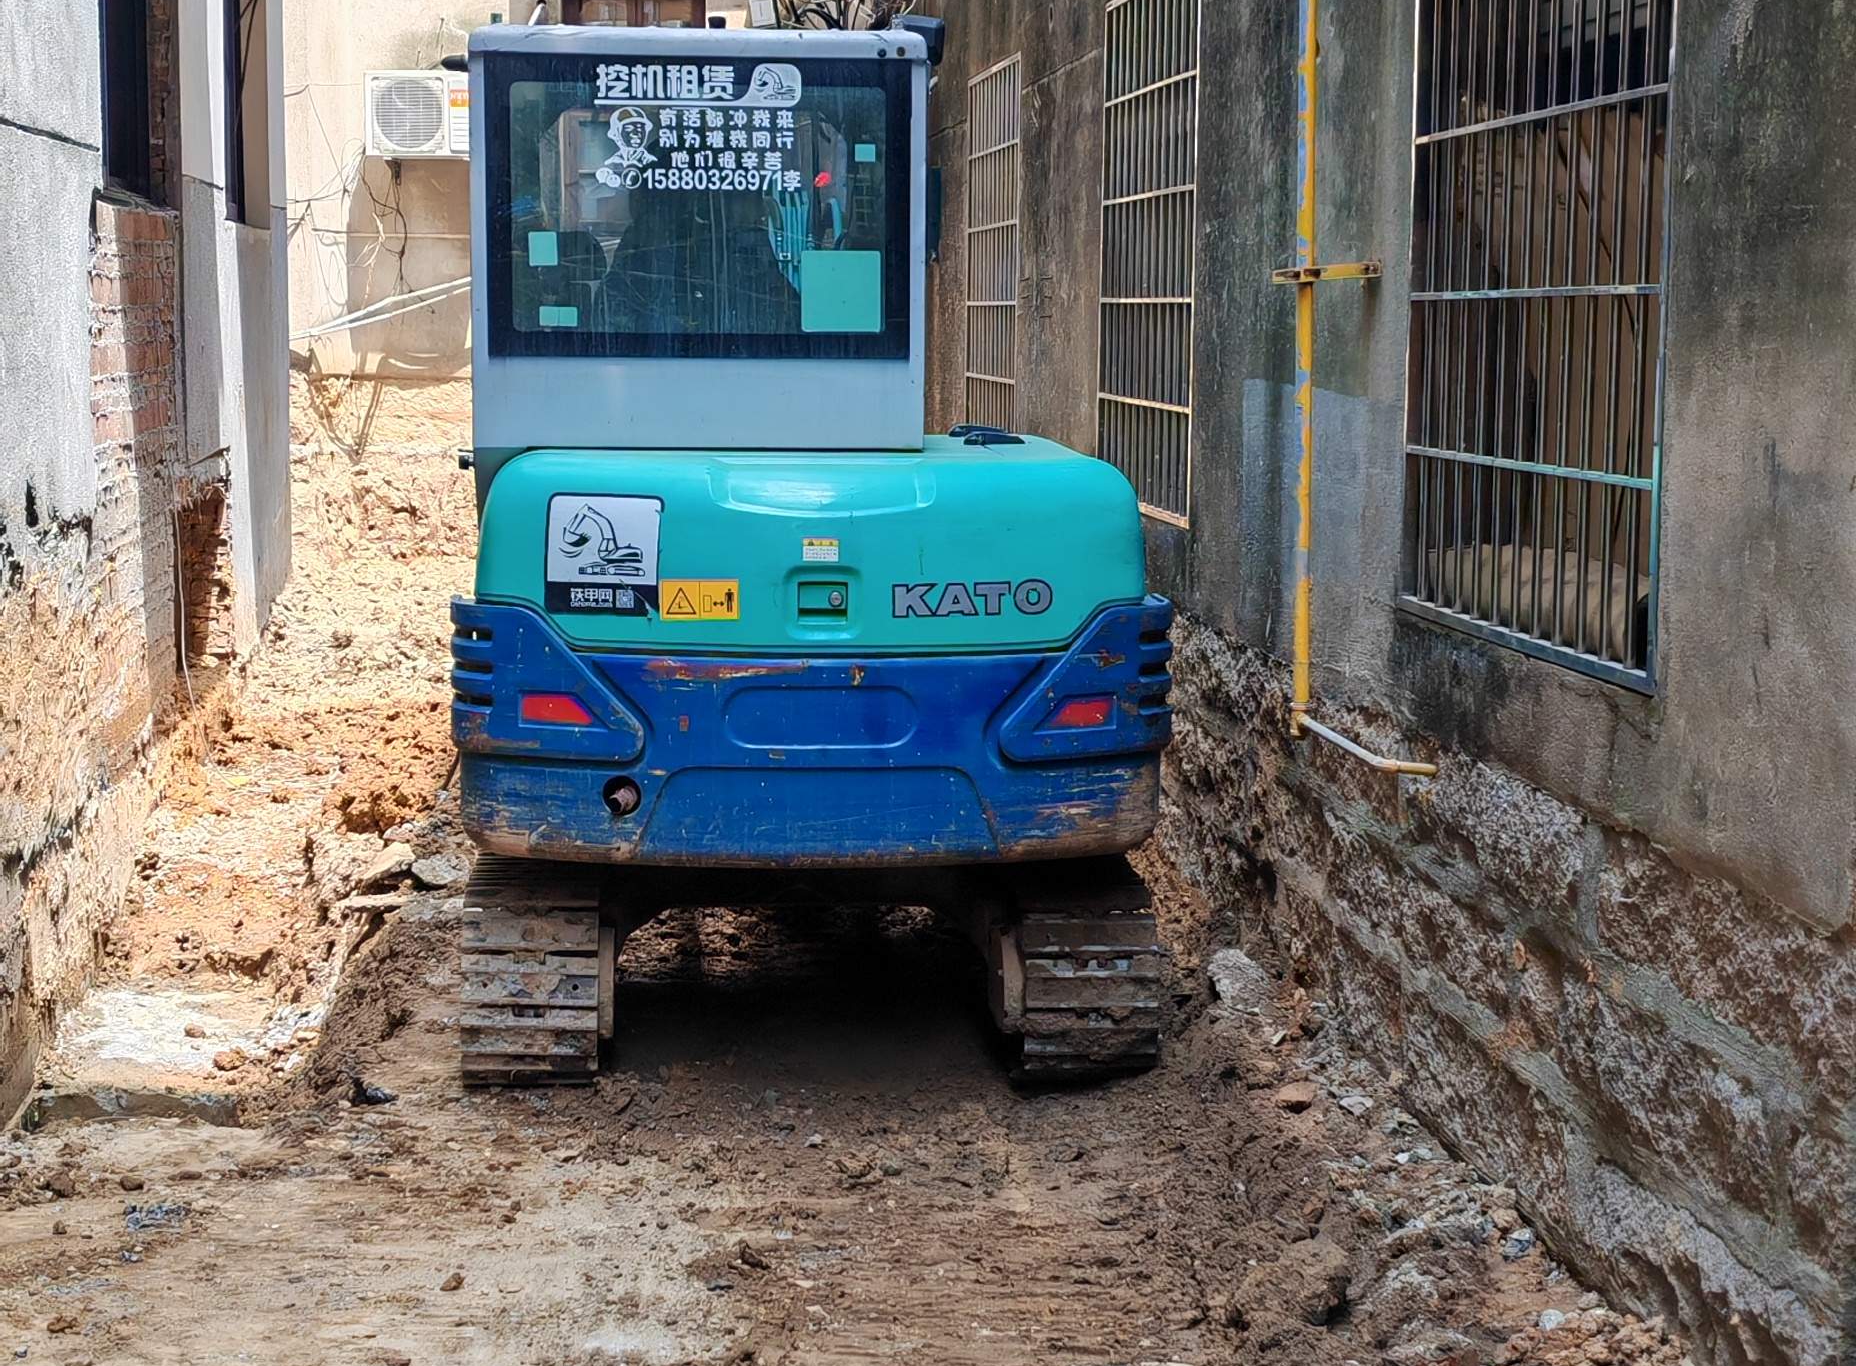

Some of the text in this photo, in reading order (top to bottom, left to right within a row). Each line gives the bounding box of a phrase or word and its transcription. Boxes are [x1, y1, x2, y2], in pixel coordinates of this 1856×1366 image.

[595, 64, 735, 100] 挖机租赁
[658, 109, 794, 128] 有活都冲我来
[658, 129, 794, 149] 别为难我同行
[670, 150, 783, 170] 他们很辛苦
[570, 588, 613, 602] 铁甲网
[892, 578, 1053, 618] KATO
